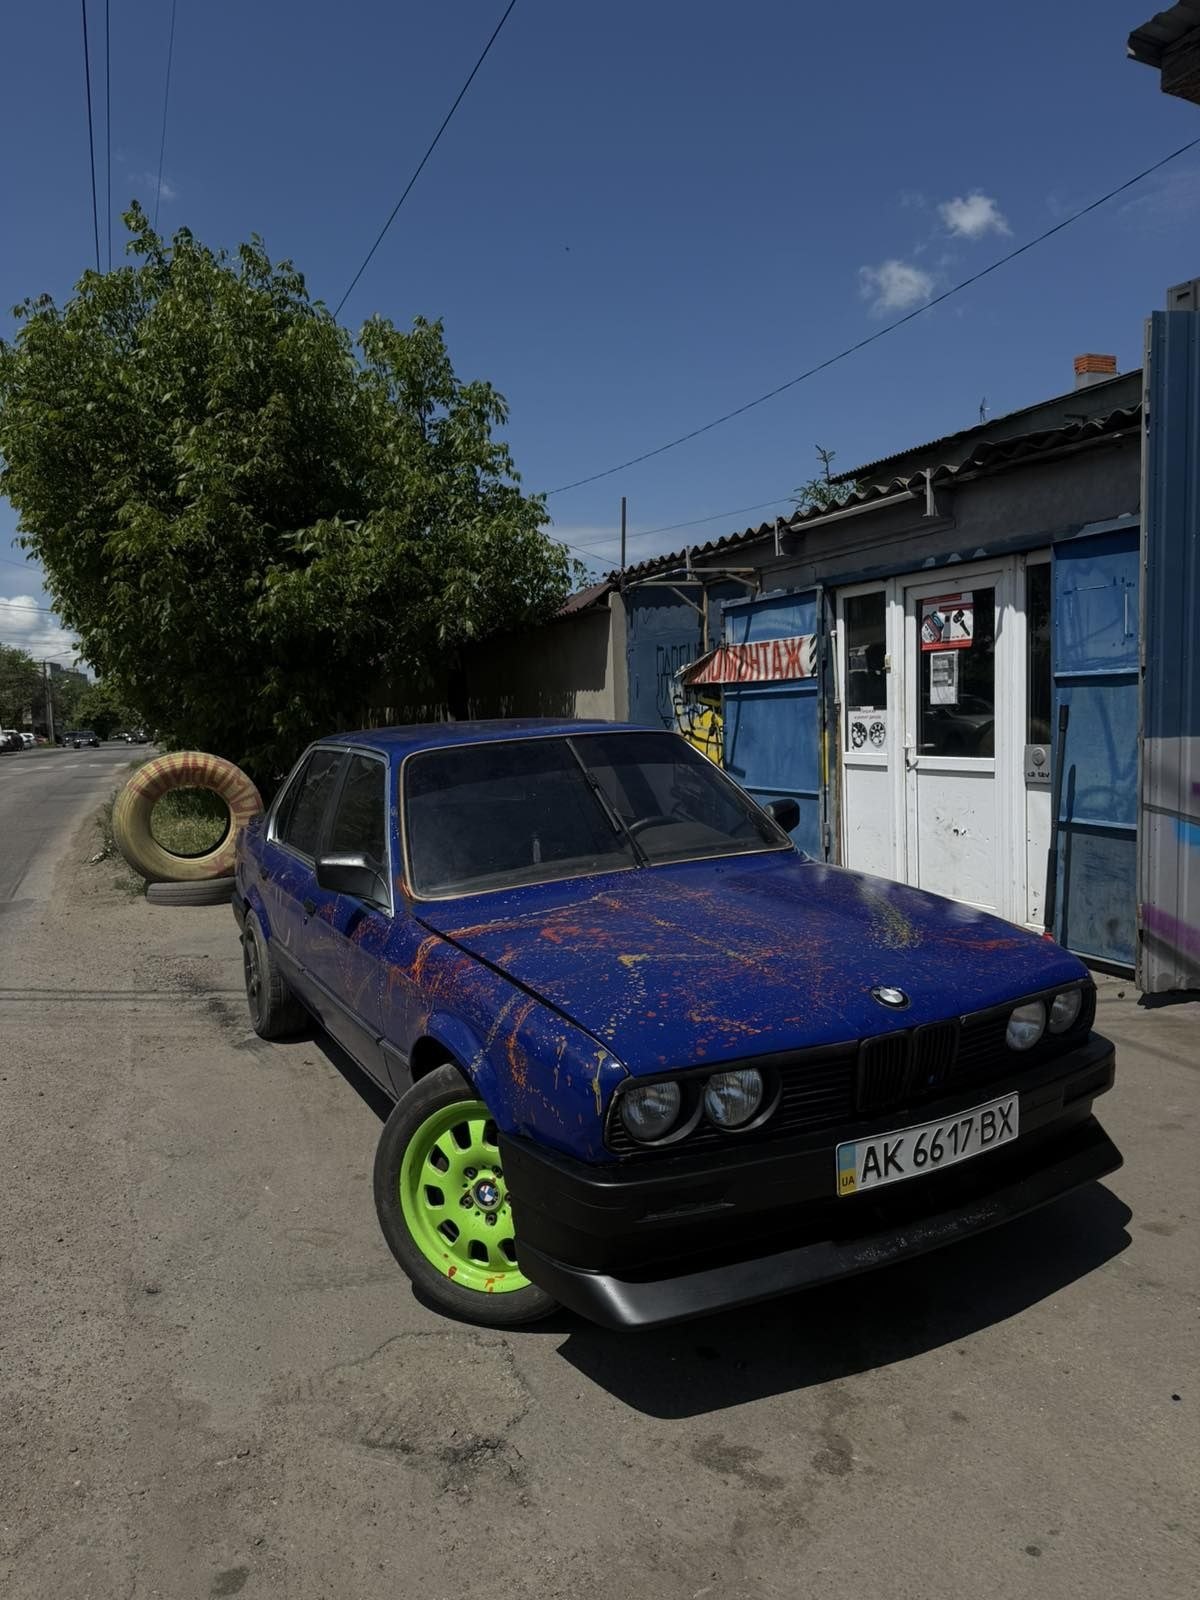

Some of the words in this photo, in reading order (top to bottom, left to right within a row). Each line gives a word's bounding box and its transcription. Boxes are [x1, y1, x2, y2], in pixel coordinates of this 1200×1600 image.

[861, 1138, 905, 1183] AK
[912, 1117, 974, 1168] 6617
[980, 1101, 1014, 1145] BX
[841, 1174, 855, 1187] UA
